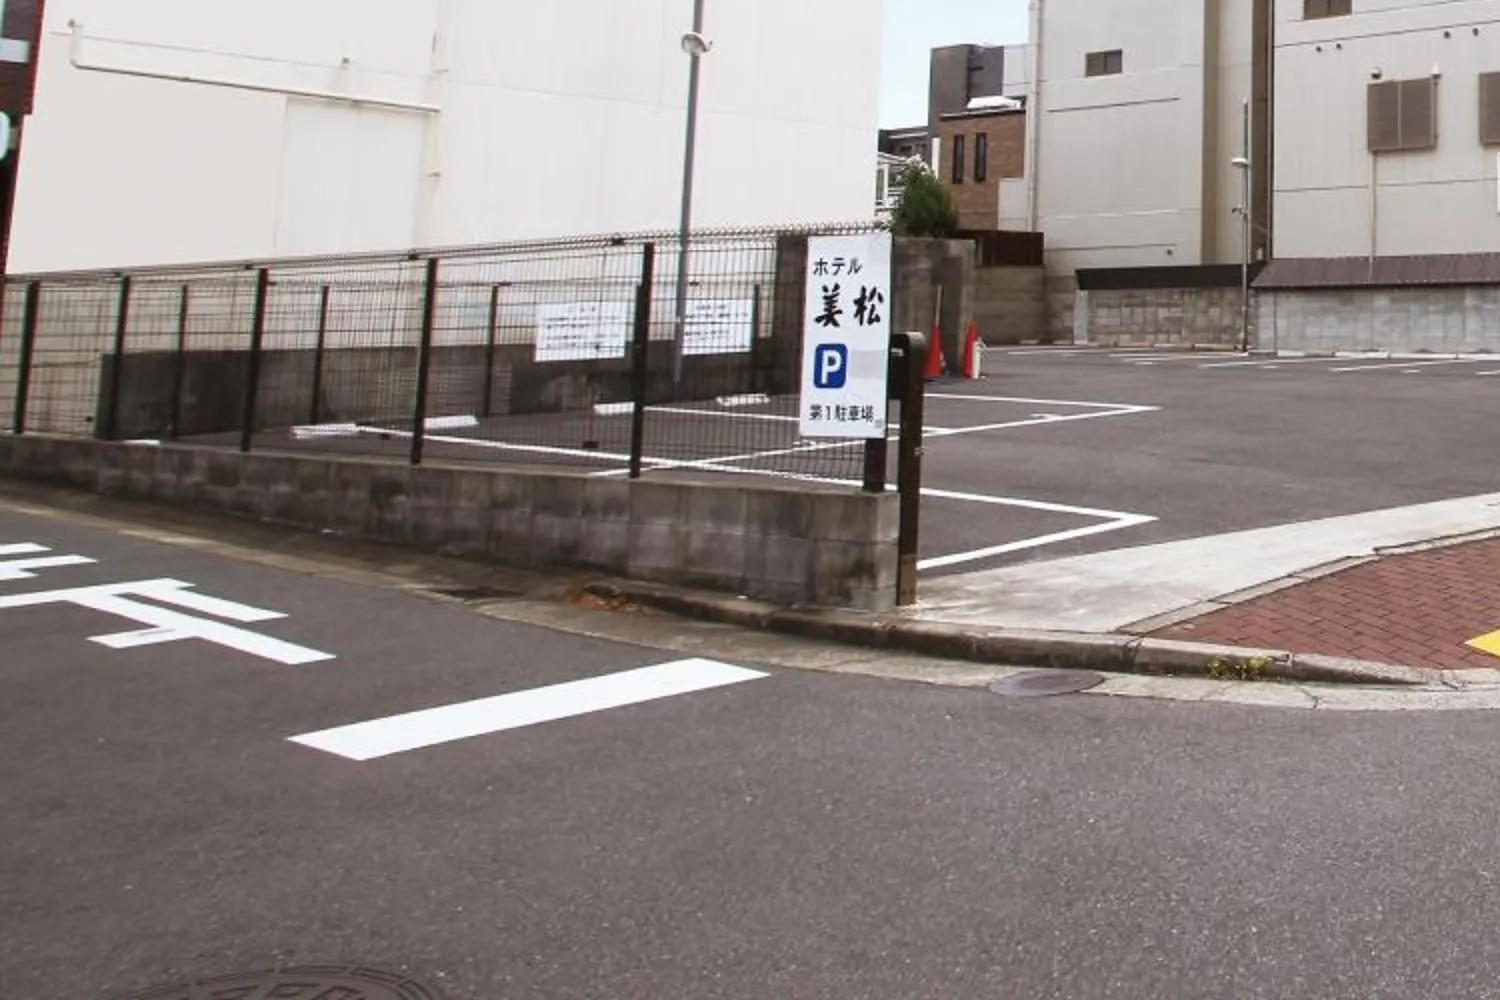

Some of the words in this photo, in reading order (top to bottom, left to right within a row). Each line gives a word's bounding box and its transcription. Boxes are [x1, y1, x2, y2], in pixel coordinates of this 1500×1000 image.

[812, 257, 863, 276] ホテル
[814, 282, 884, 328] 美松
[808, 404, 876, 423] 第1駐車場
